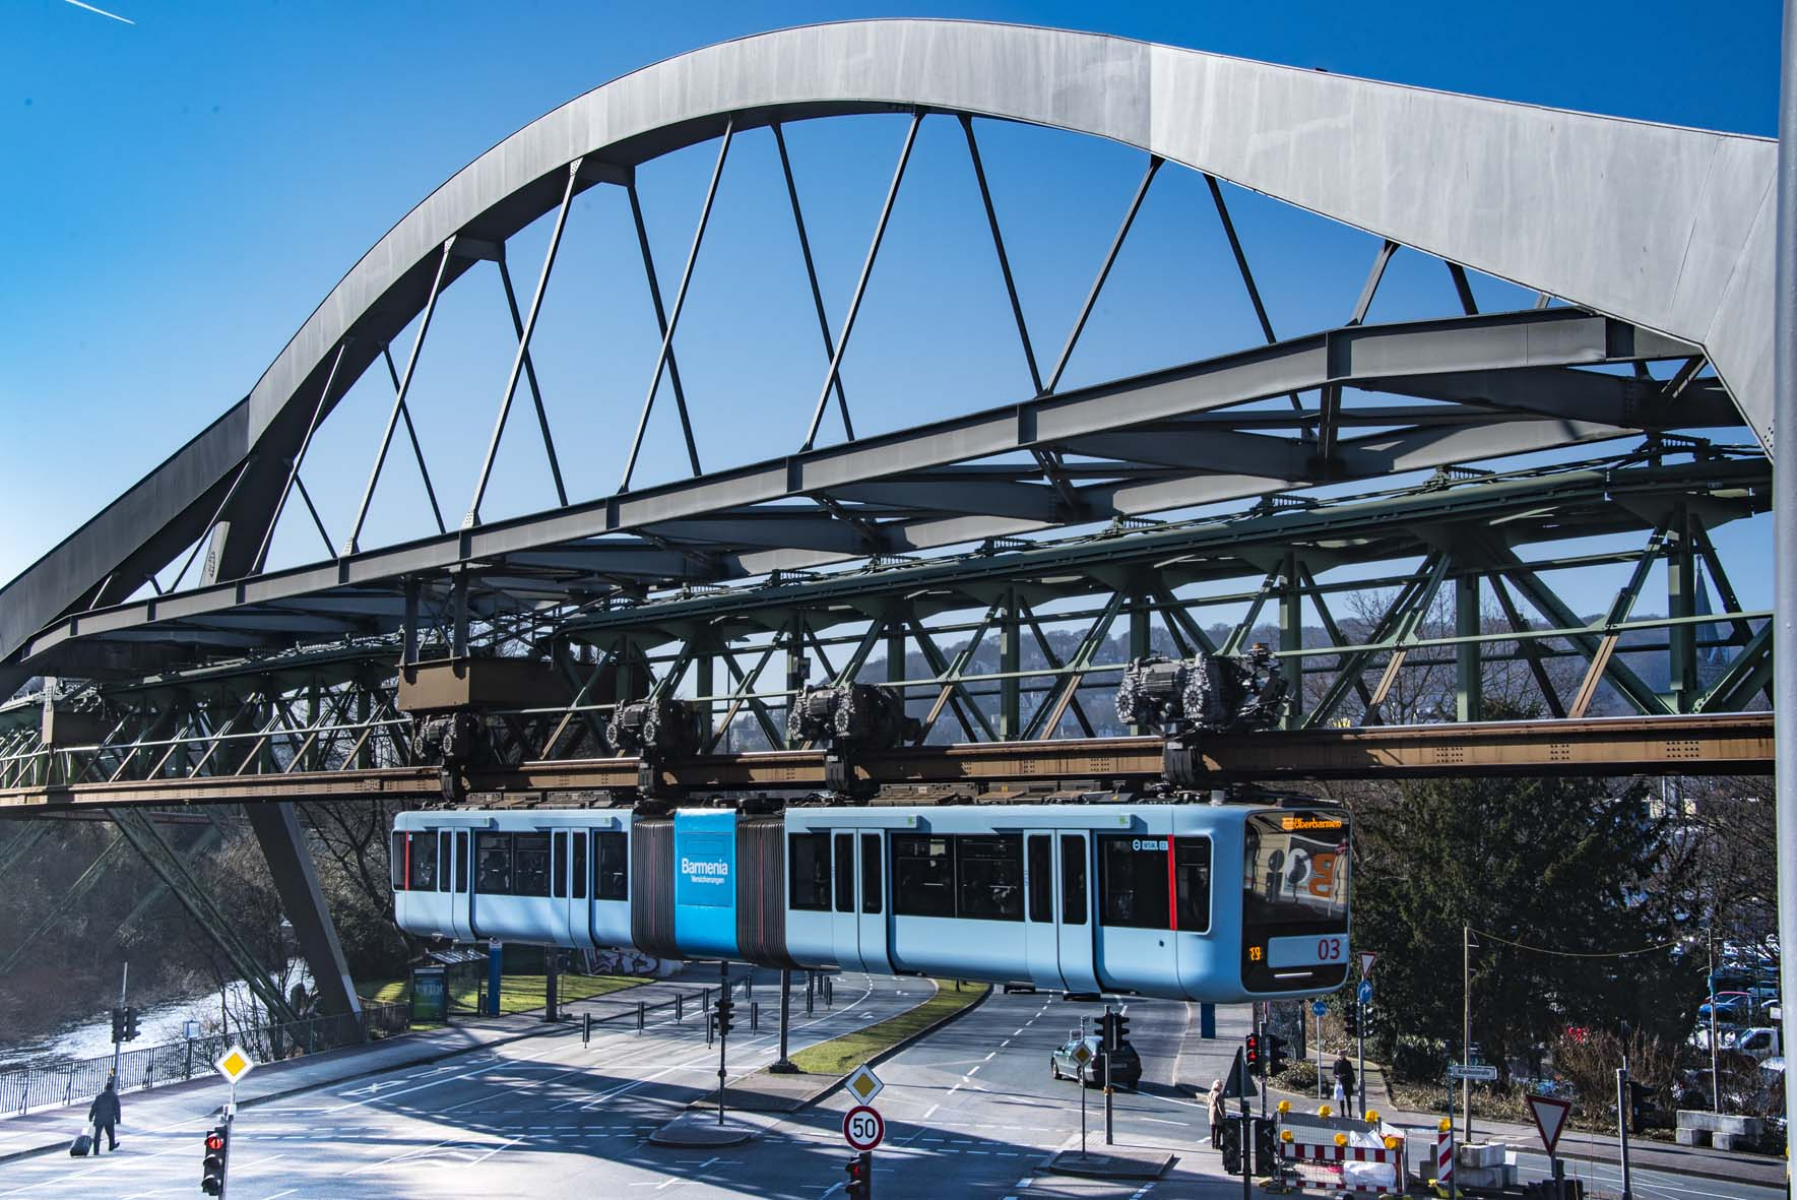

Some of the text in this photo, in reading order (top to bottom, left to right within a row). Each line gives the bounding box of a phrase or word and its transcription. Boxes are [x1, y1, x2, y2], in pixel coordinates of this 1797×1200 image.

[682, 858, 728, 875] Barmenia
[1318, 939, 1340, 960] 03
[853, 1118, 876, 1138] 50
